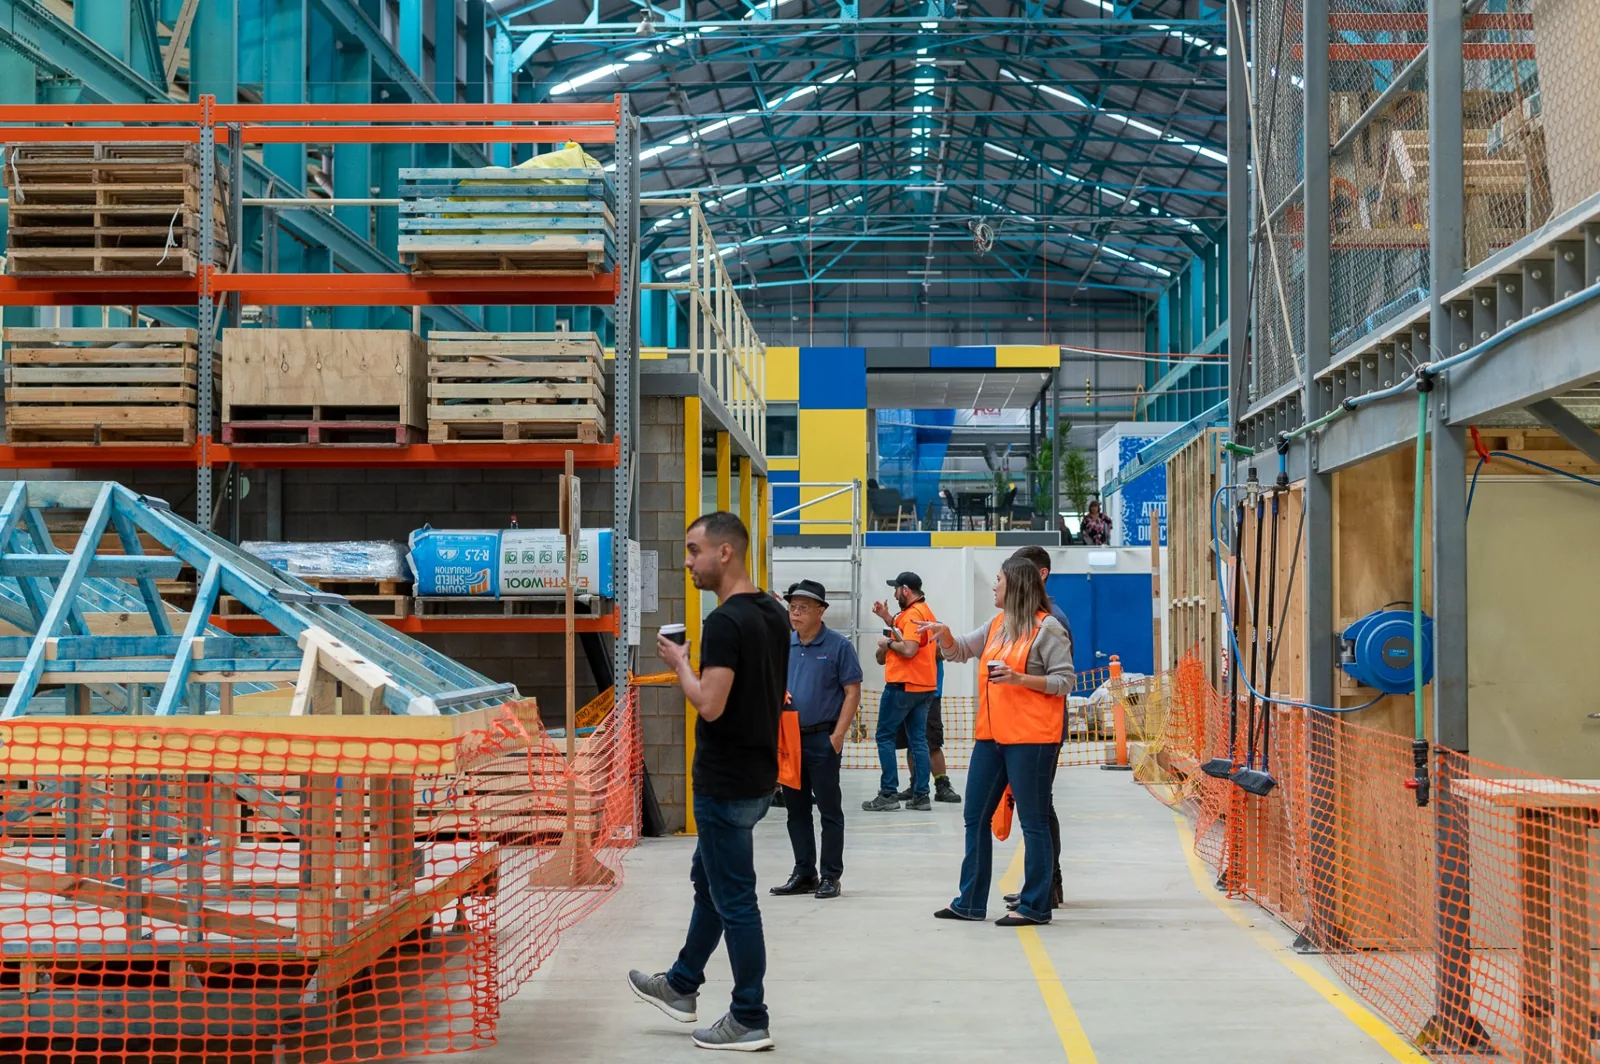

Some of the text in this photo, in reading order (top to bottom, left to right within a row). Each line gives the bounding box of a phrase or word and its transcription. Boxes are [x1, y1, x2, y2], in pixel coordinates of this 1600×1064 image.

[1141, 501, 1168, 517] ATTIT
[465, 549, 490, 561] R-2.5
[435, 566, 472, 574] INSULATION
[435, 575, 465, 585] SHIELD
[504, 576, 588, 589] ERTHWOOL
[435, 585, 467, 594] SOUND
